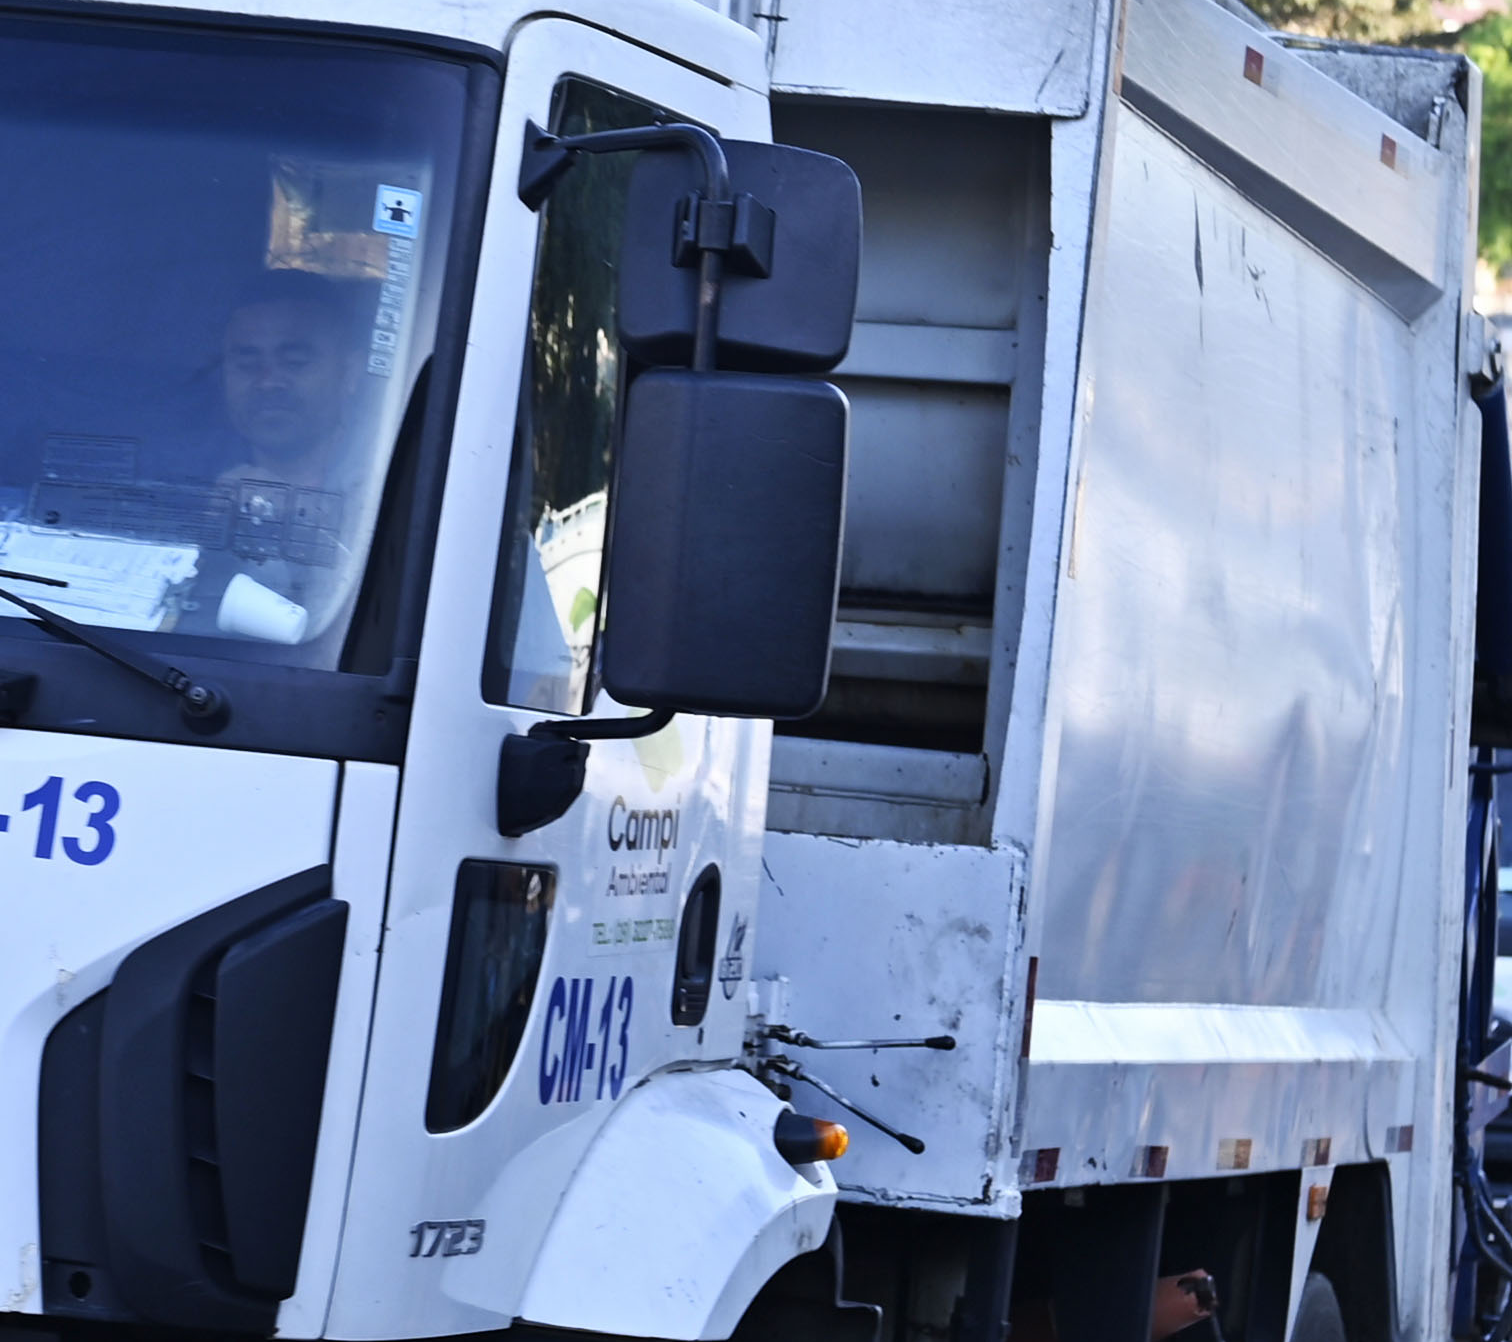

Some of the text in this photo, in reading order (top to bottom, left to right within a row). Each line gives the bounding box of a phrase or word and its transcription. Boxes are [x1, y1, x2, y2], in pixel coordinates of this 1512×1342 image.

[607, 792, 682, 865] Campi
[605, 862, 672, 897] Ambiental
[539, 975, 634, 1106] CM-13
[408, 1218, 486, 1258] 1723
